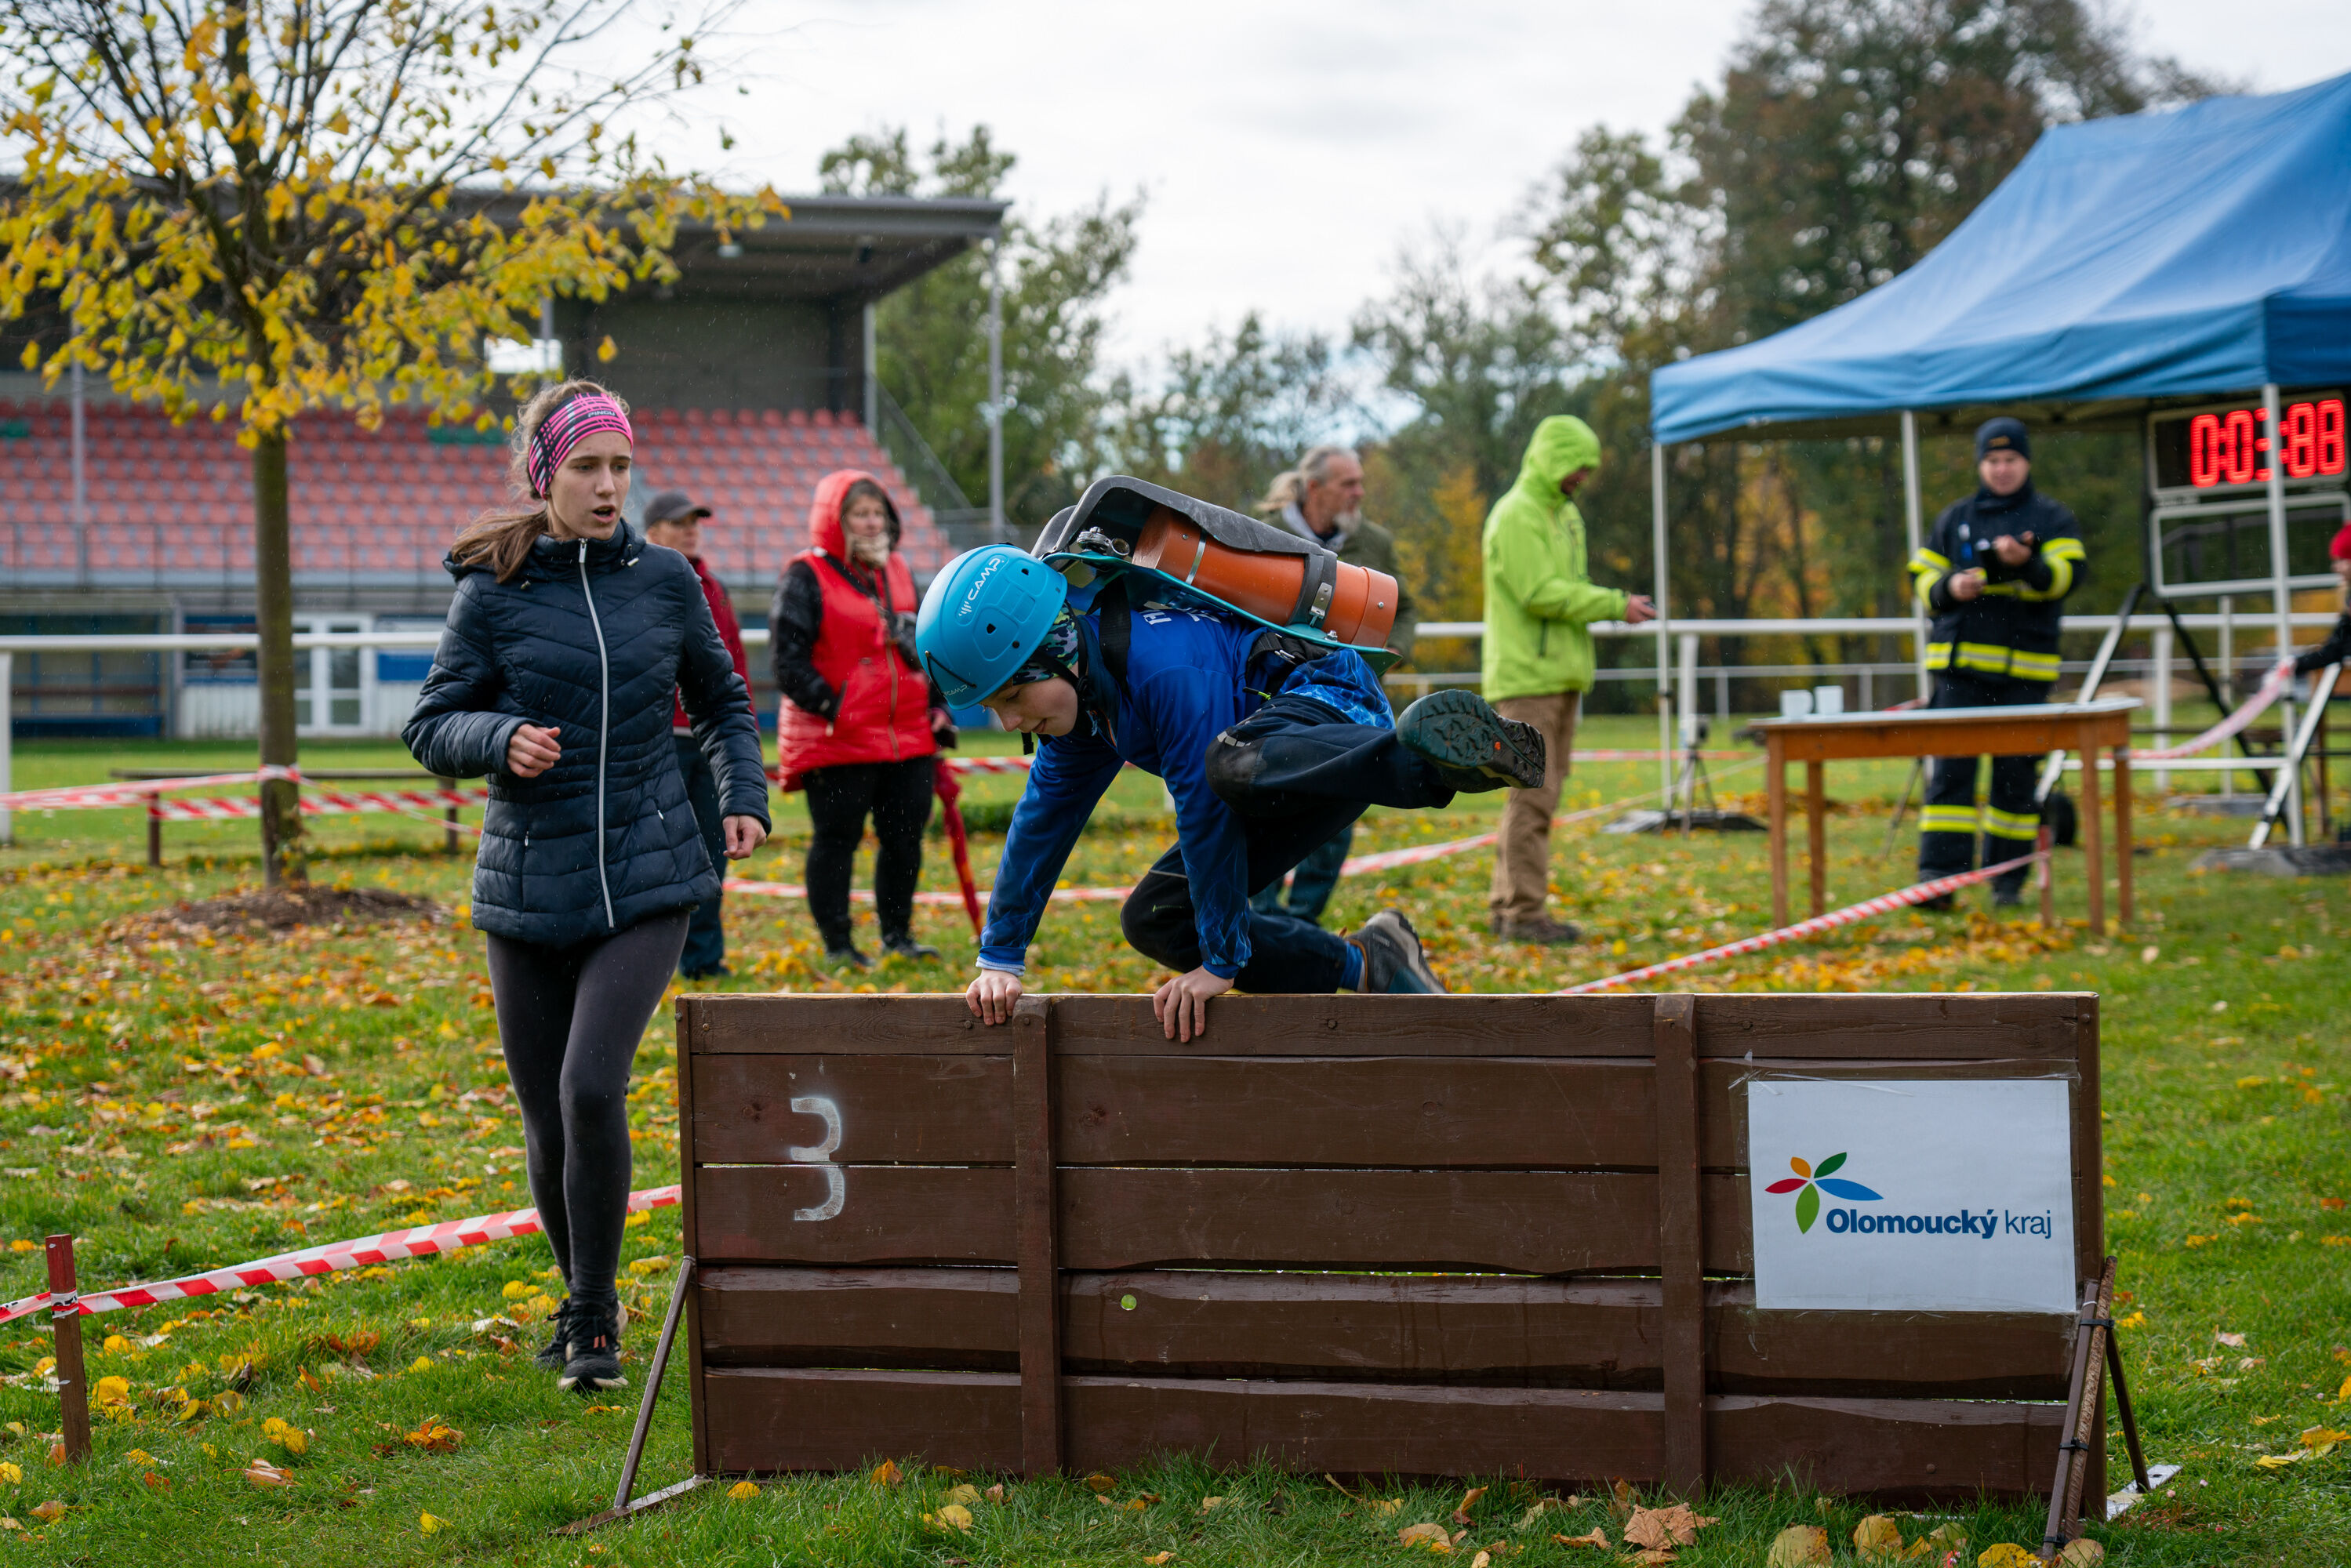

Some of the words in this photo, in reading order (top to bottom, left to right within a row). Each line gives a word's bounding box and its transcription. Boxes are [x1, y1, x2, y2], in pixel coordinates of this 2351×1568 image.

[967, 557, 1001, 601] CAMP
[790, 1098, 845, 1221] 3
[1826, 1208, 1999, 1240] Olomoucký
[2005, 1210, 2051, 1240] kraj
